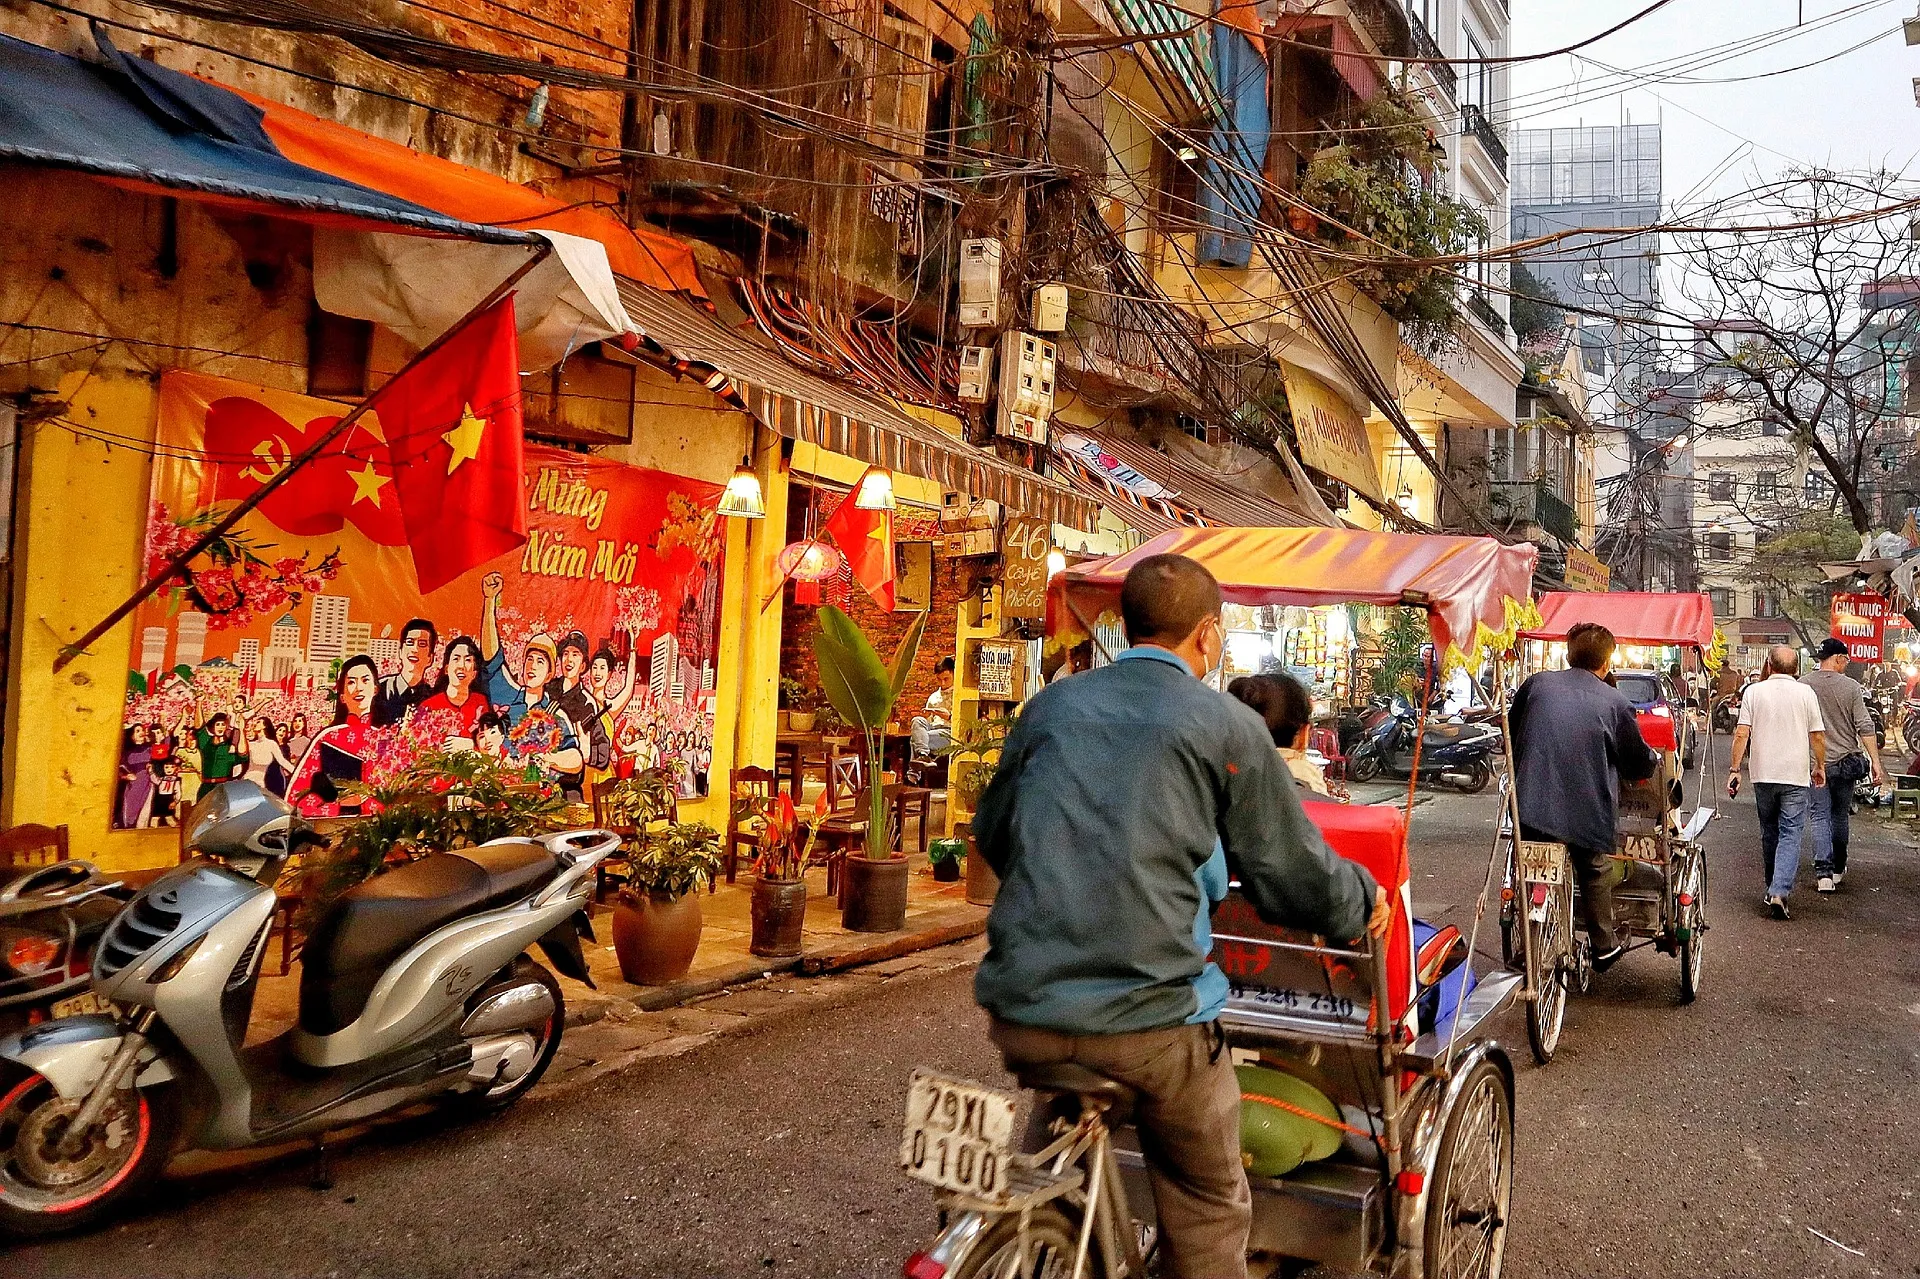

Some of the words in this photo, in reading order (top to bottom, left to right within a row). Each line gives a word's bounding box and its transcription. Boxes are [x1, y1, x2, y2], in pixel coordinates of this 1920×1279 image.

[530, 467, 608, 530] Mừng
[521, 530, 587, 579] Năm
[589, 540, 639, 584] Mới
[1007, 522, 1048, 560] 46
[1835, 597, 1855, 616] CHẢ
[1859, 602, 1882, 619] MỰC
[1851, 644, 1878, 658] LONG
[923, 1087, 991, 1144] 29XL
[912, 1129, 996, 1192] 0100
